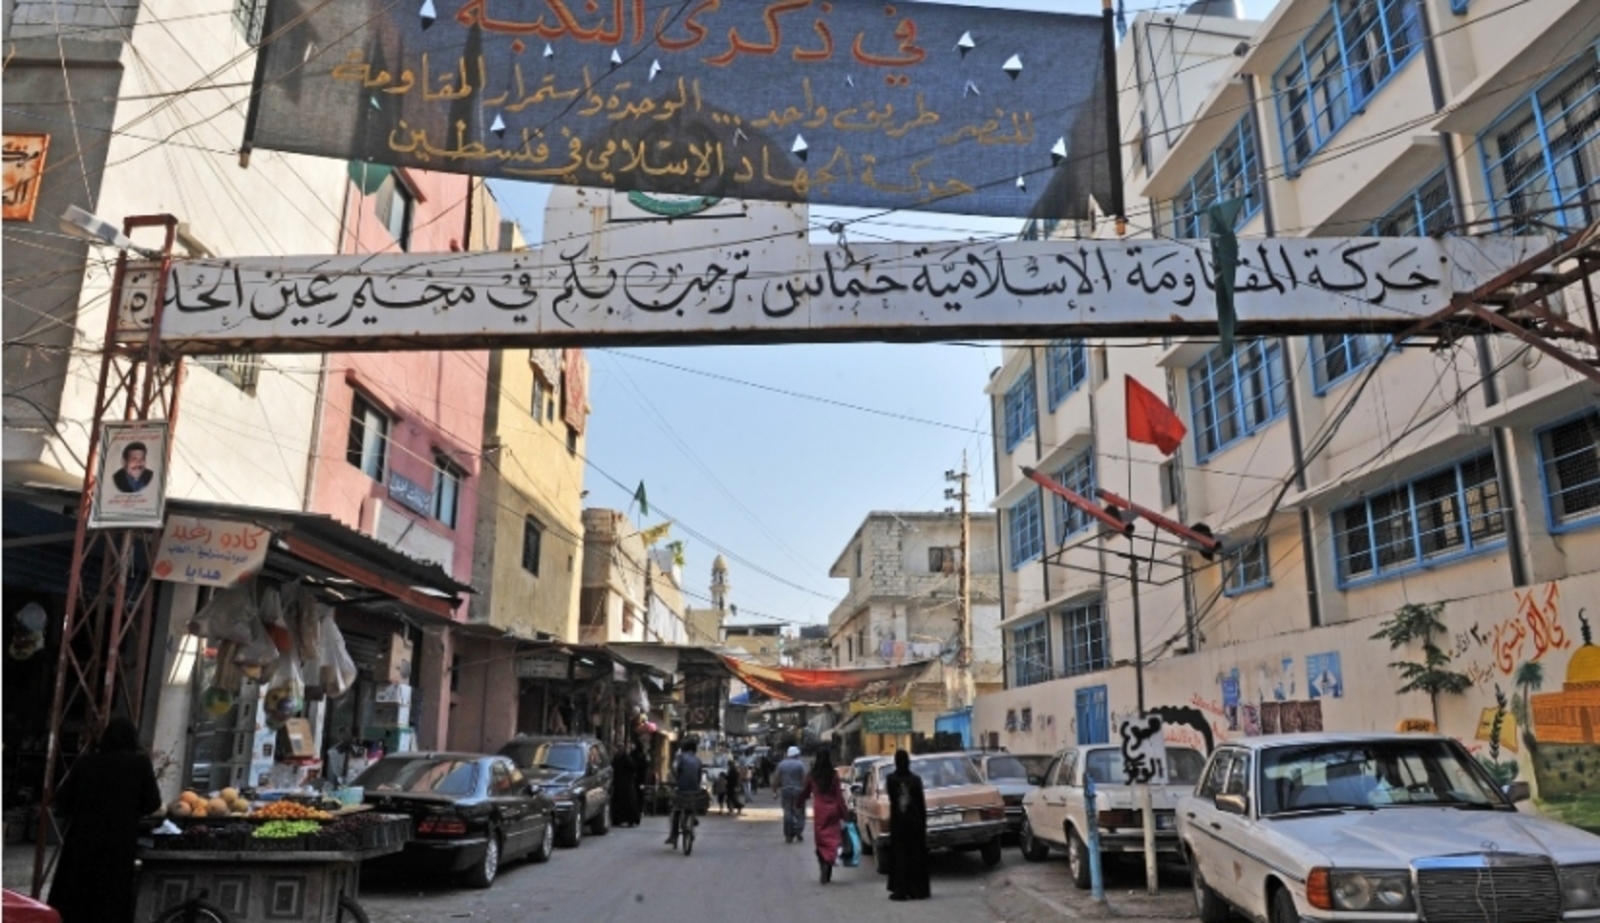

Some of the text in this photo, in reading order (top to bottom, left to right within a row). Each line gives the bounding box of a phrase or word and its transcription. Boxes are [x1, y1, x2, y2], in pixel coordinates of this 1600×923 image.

[655, 0, 835, 67] ذكرى
[852, 3, 927, 87] في
[331, 50, 487, 102] المقاومة
[607, 75, 702, 121] الوحدة
[388, 118, 549, 163] فلسطين
[832, 91, 941, 138] طريق
[502, 126, 583, 184] في
[733, 144, 852, 196] الجهاد
[860, 153, 977, 203] حركة
[130, 262, 244, 326] الحلة
[250, 268, 339, 327] عين
[326, 260, 476, 329] مخيم
[485, 254, 539, 324] في
[551, 242, 618, 329] بكم
[623, 248, 750, 318] ترحب
[761, 249, 910, 318] حماس
[1125, 243, 1299, 308] المقاومة
[1304, 240, 1441, 305] حركة
